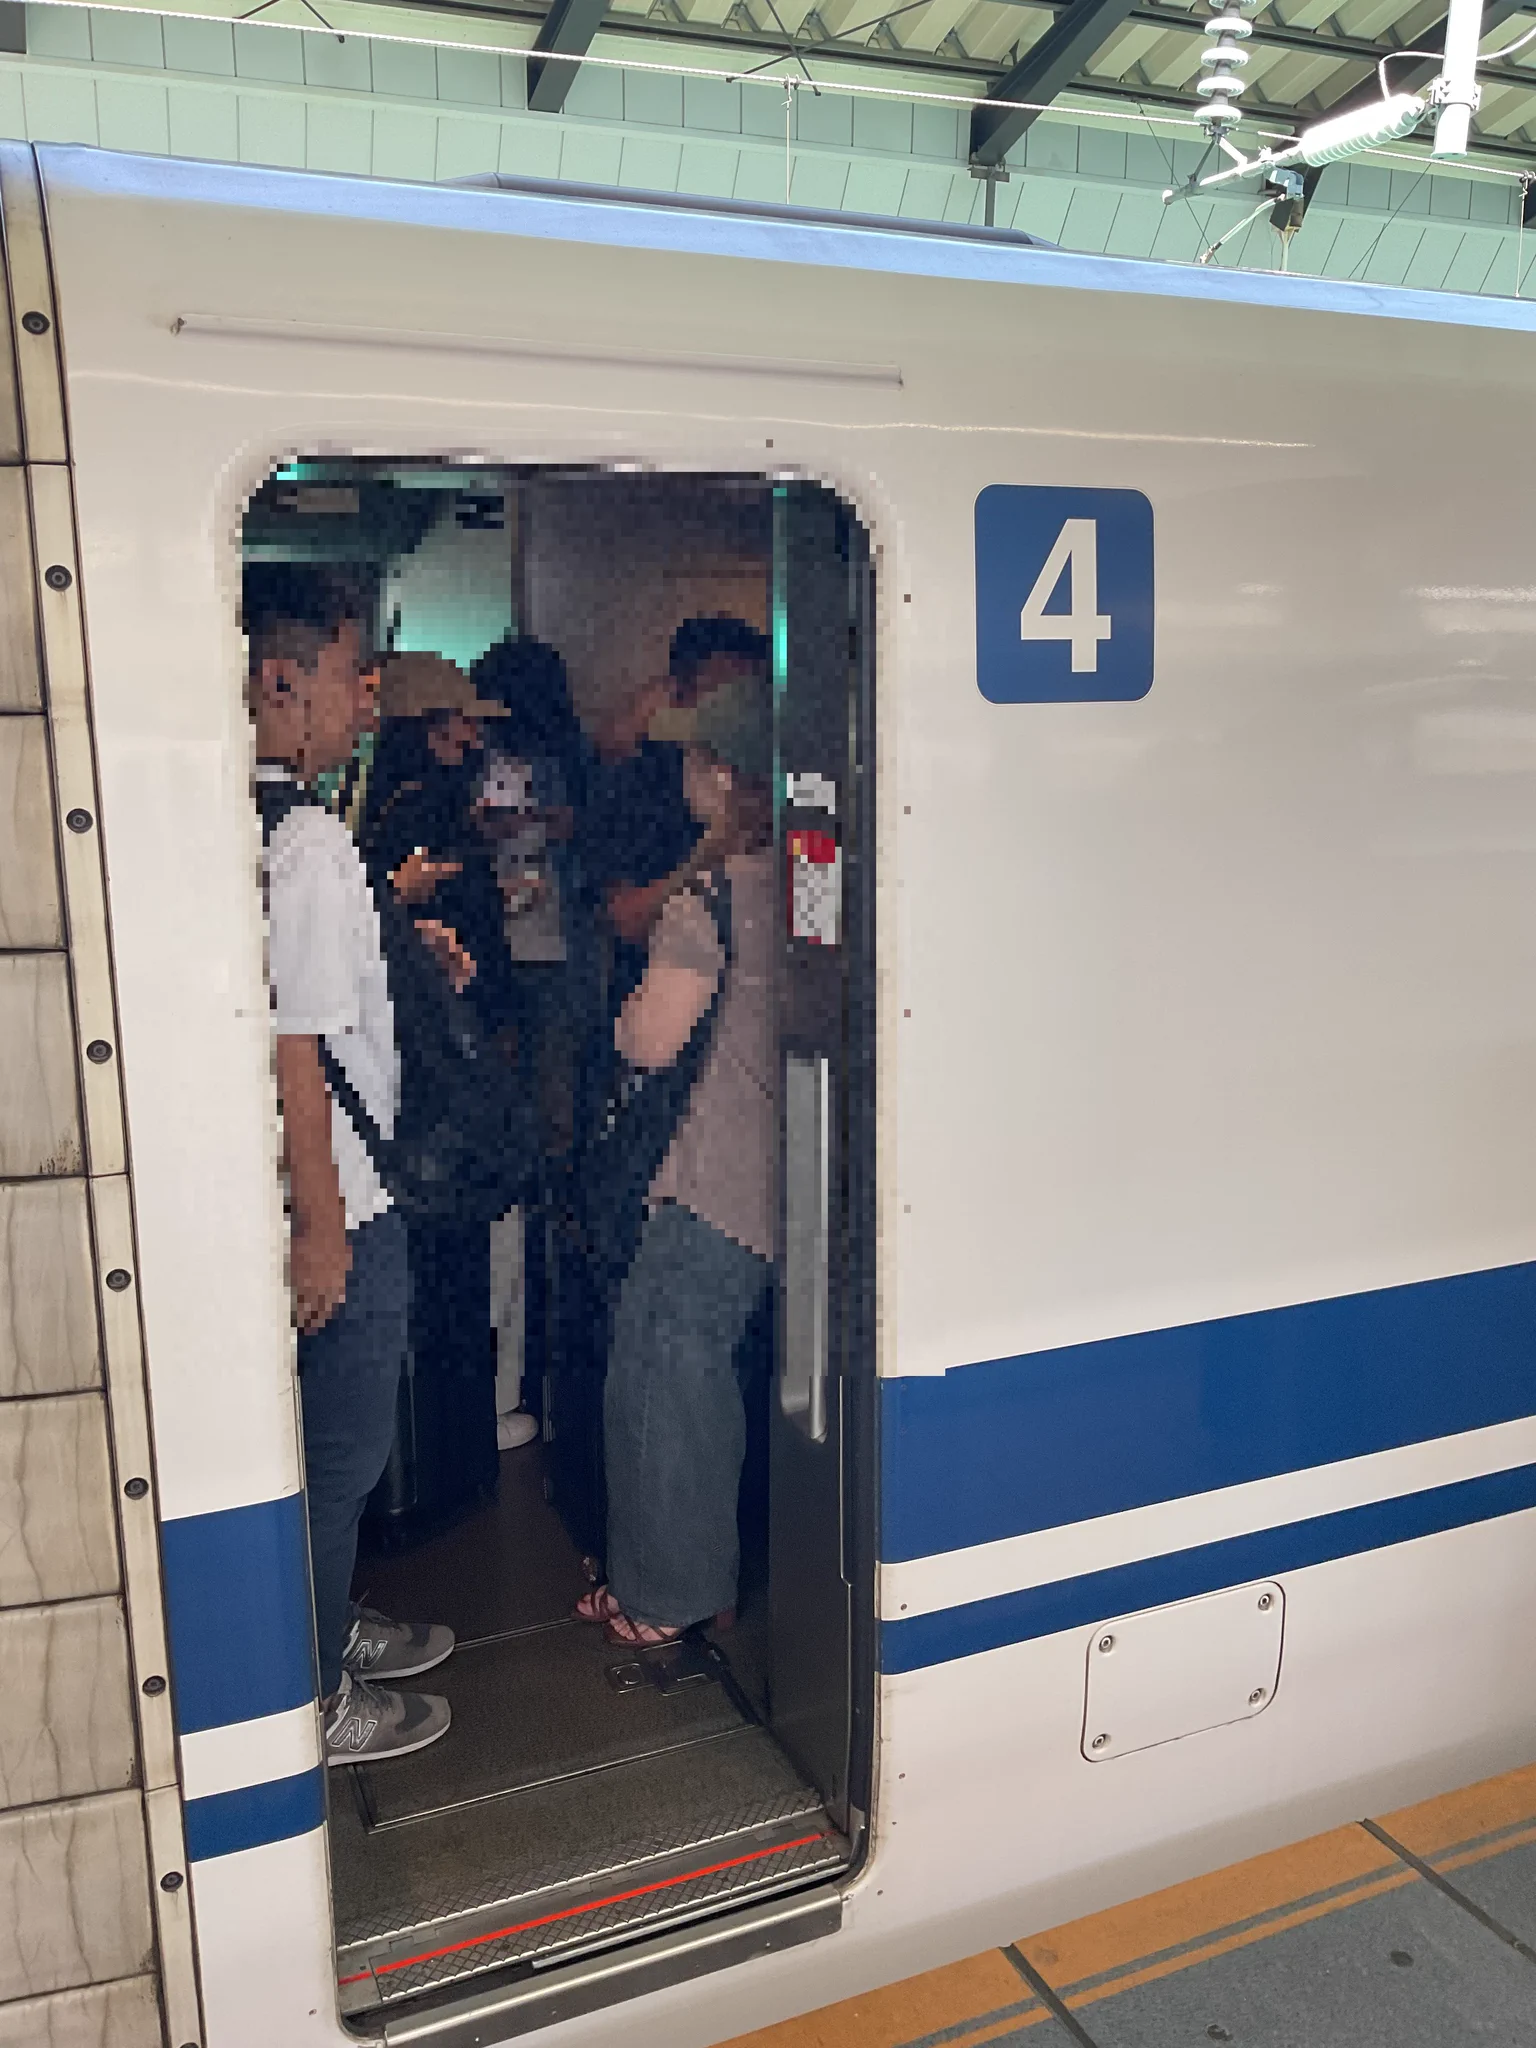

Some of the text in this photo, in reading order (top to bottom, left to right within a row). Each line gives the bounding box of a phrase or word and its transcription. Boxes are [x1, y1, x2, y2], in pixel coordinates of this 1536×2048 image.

[1020, 518, 1112, 673] 4
[350, 1638, 388, 1669] N
[331, 1717, 378, 1752] N
